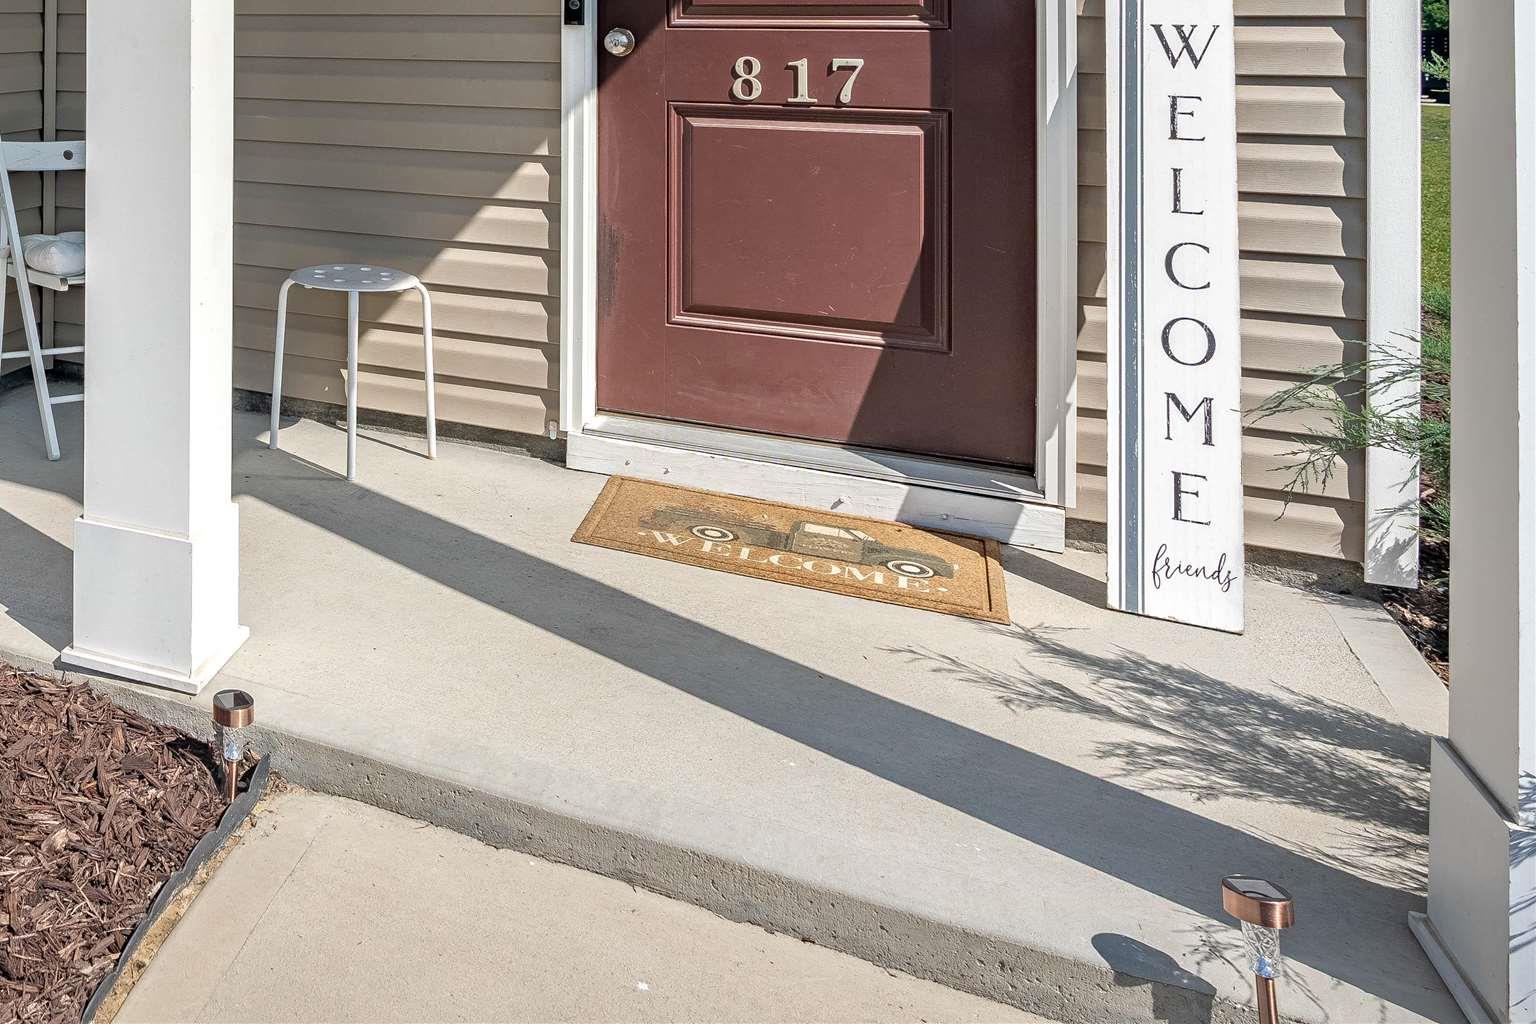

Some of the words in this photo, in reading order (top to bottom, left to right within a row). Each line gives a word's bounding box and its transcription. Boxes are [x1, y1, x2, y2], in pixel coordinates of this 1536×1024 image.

[731, 55, 865, 104] 817
[1150, 24, 1220, 526] WELCOME
[651, 529, 930, 593] WELCOME
[1151, 543, 1238, 593] friends
